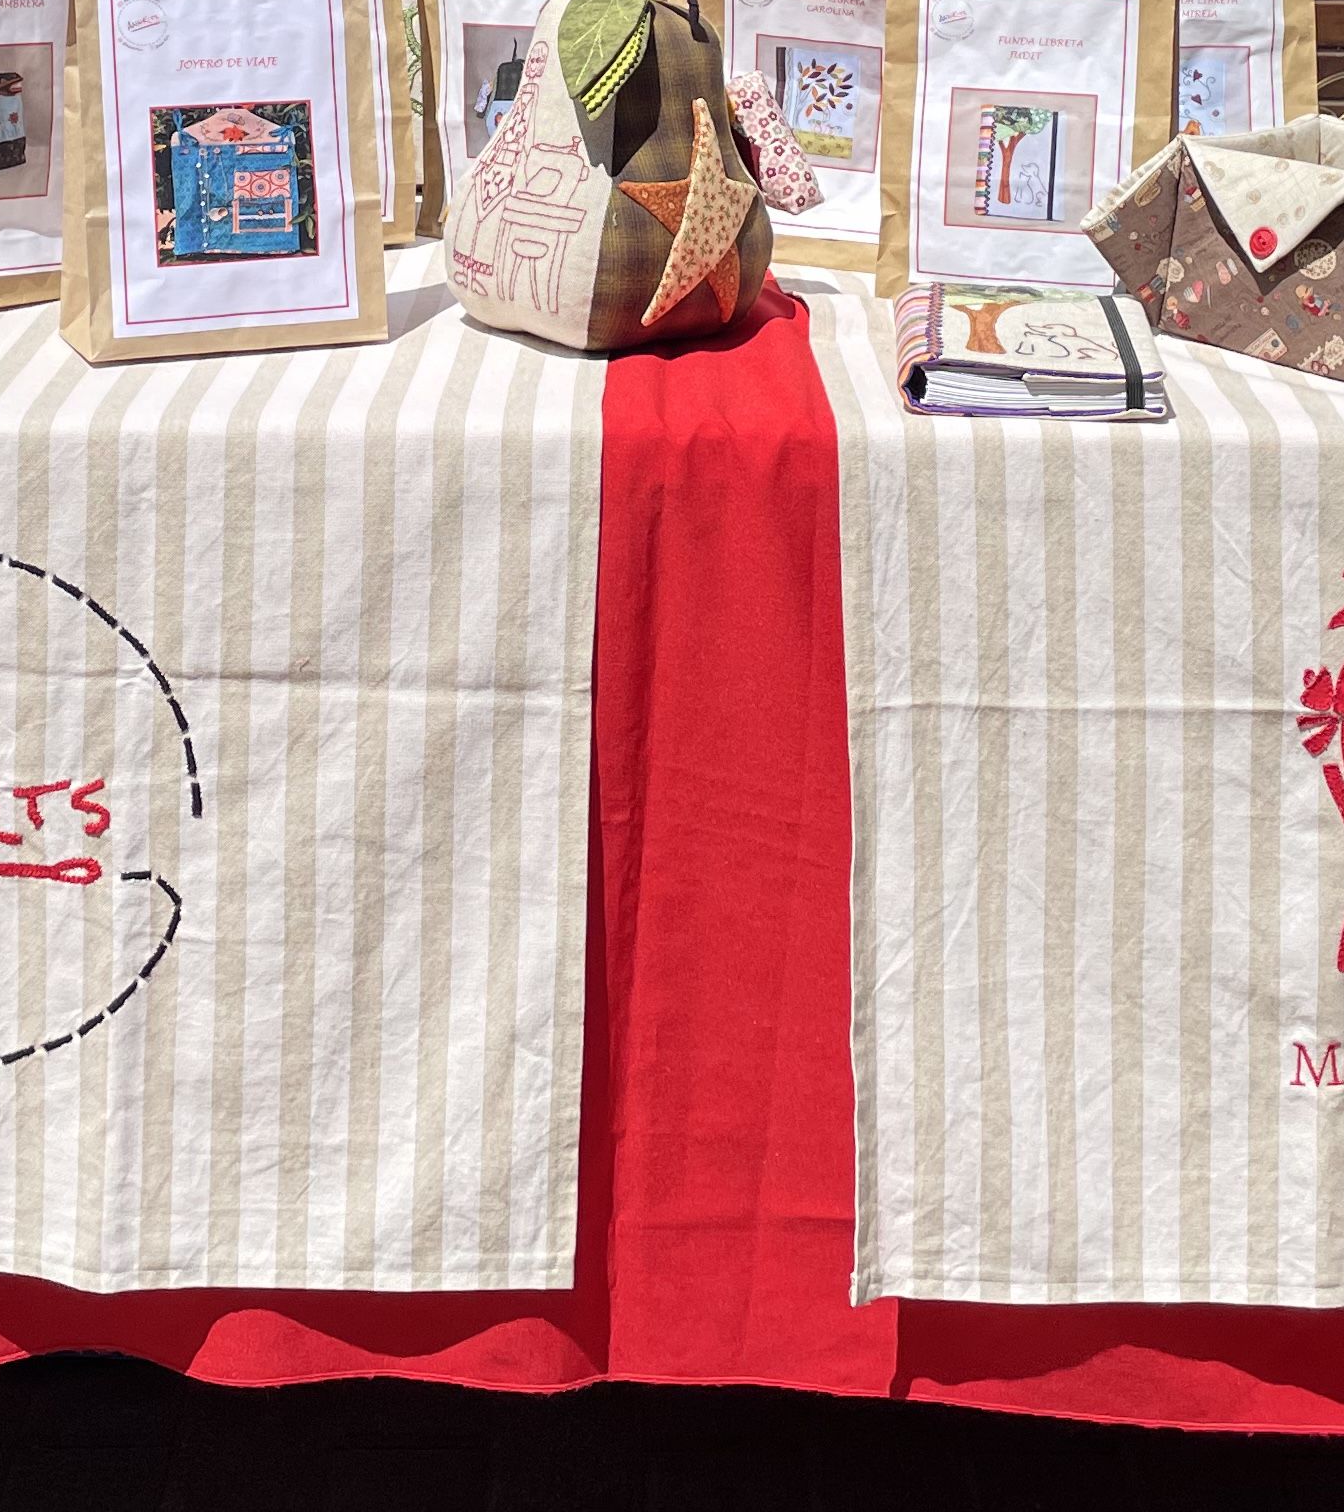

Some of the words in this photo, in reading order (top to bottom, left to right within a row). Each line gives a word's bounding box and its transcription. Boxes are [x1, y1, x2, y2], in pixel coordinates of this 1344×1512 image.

[807, 5, 856, 18] CAROLINA
[999, 35, 1035, 47] FUNDA
[1039, 37, 1085, 49] LIBRETA
[1008, 50, 1044, 62] JUDIT
[176, 57, 224, 72] JOYERO
[227, 56, 243, 69] DE
[246, 55, 279, 69] VIAJE
